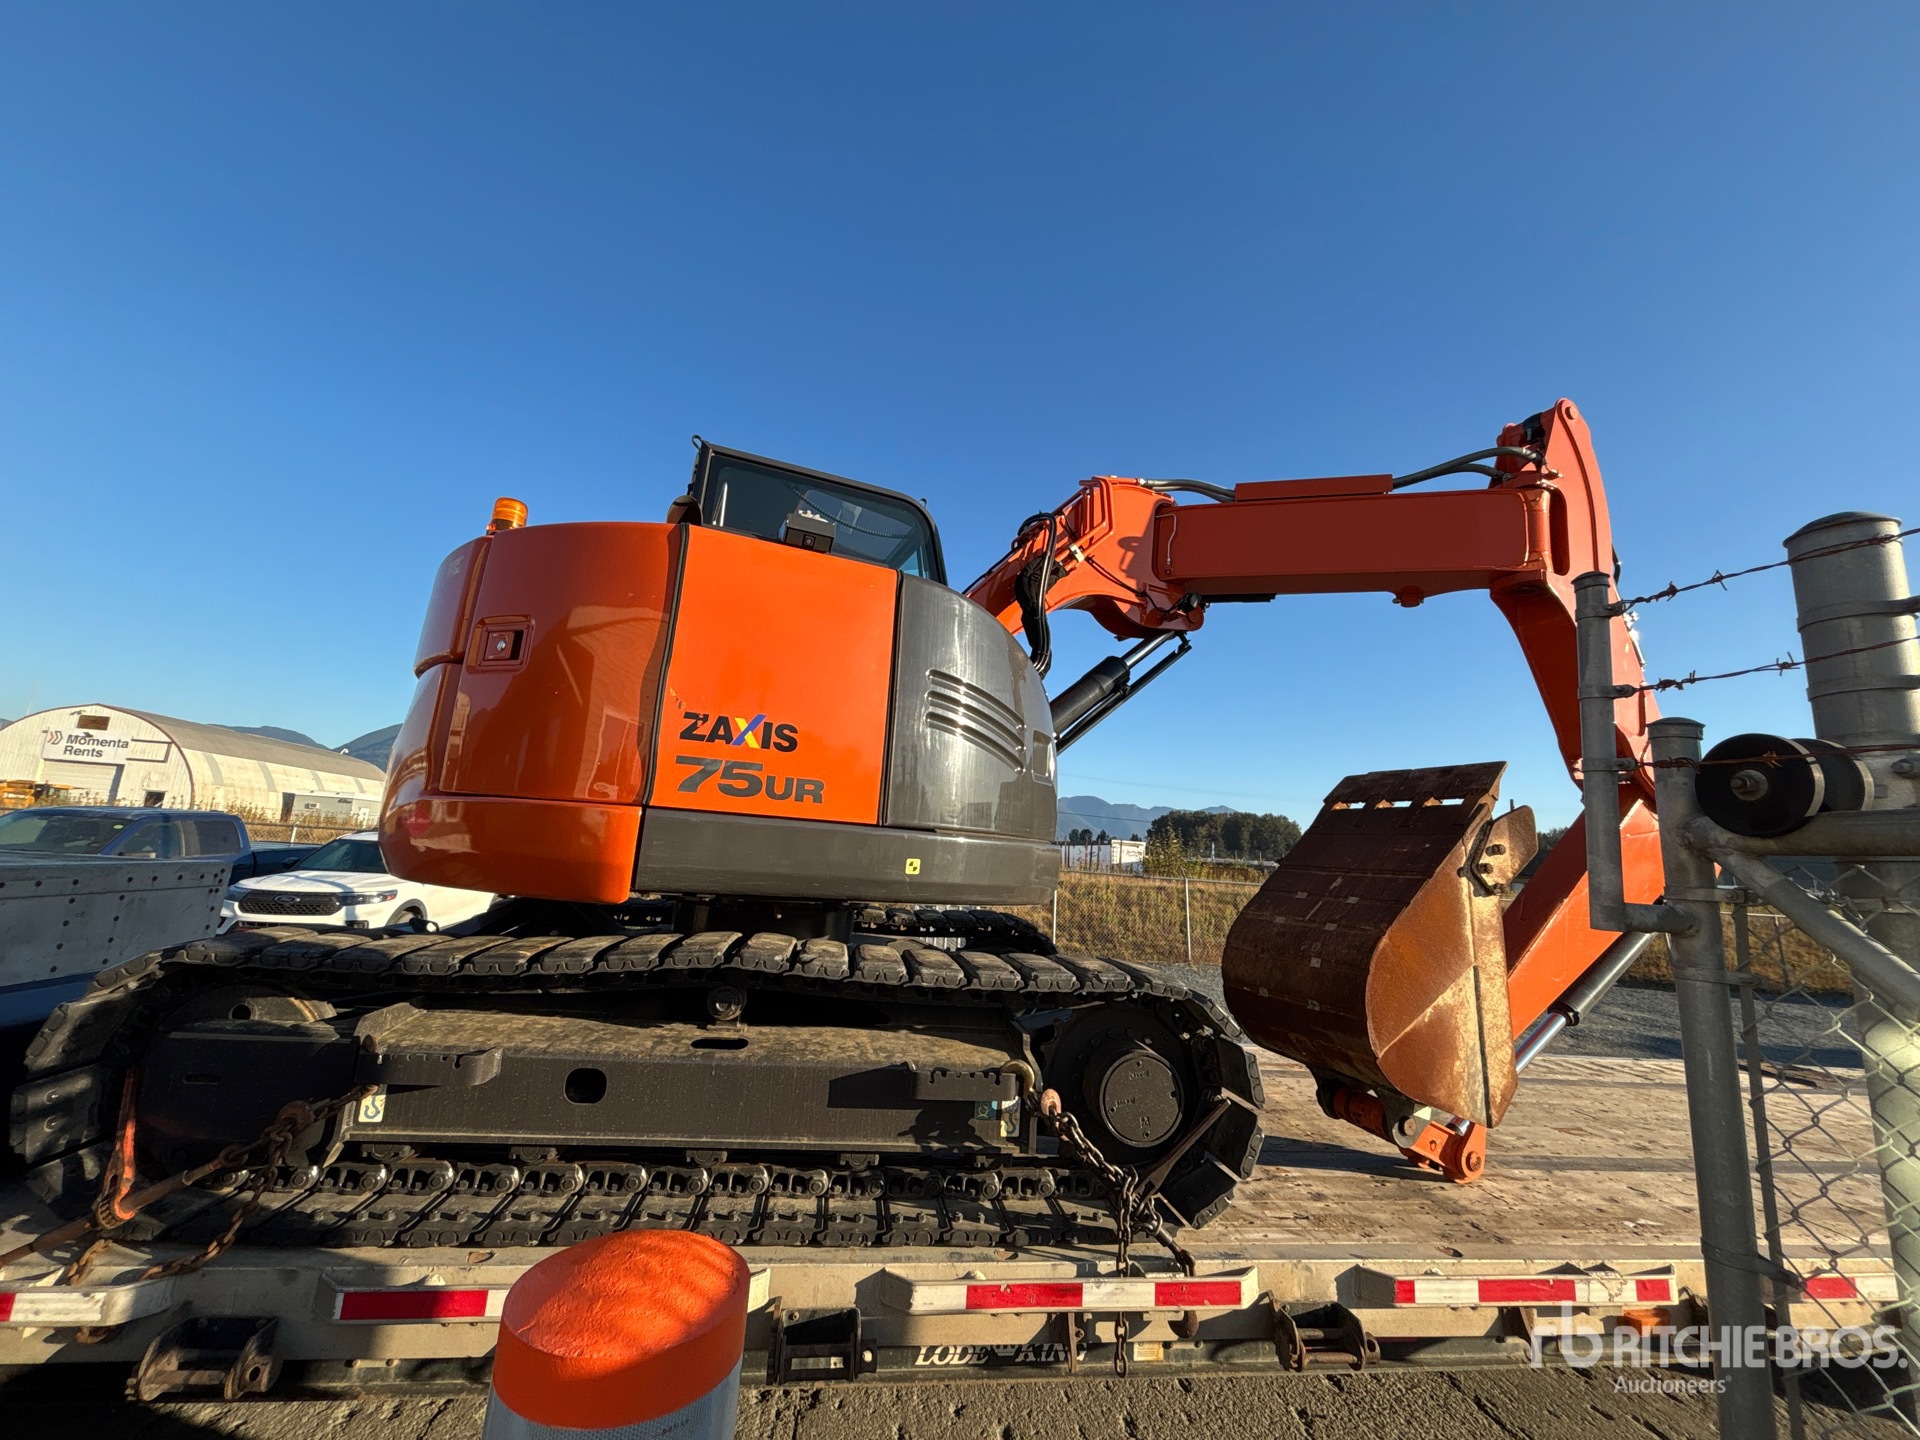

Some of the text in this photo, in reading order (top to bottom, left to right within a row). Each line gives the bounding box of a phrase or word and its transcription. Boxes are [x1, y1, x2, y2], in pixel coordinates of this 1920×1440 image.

[66, 734, 129, 748] Momenta
[679, 712, 798, 752] ZAXIS
[63, 745, 103, 758] Rents
[675, 755, 825, 804] 75UR
[915, 1344, 990, 1365] LODE
